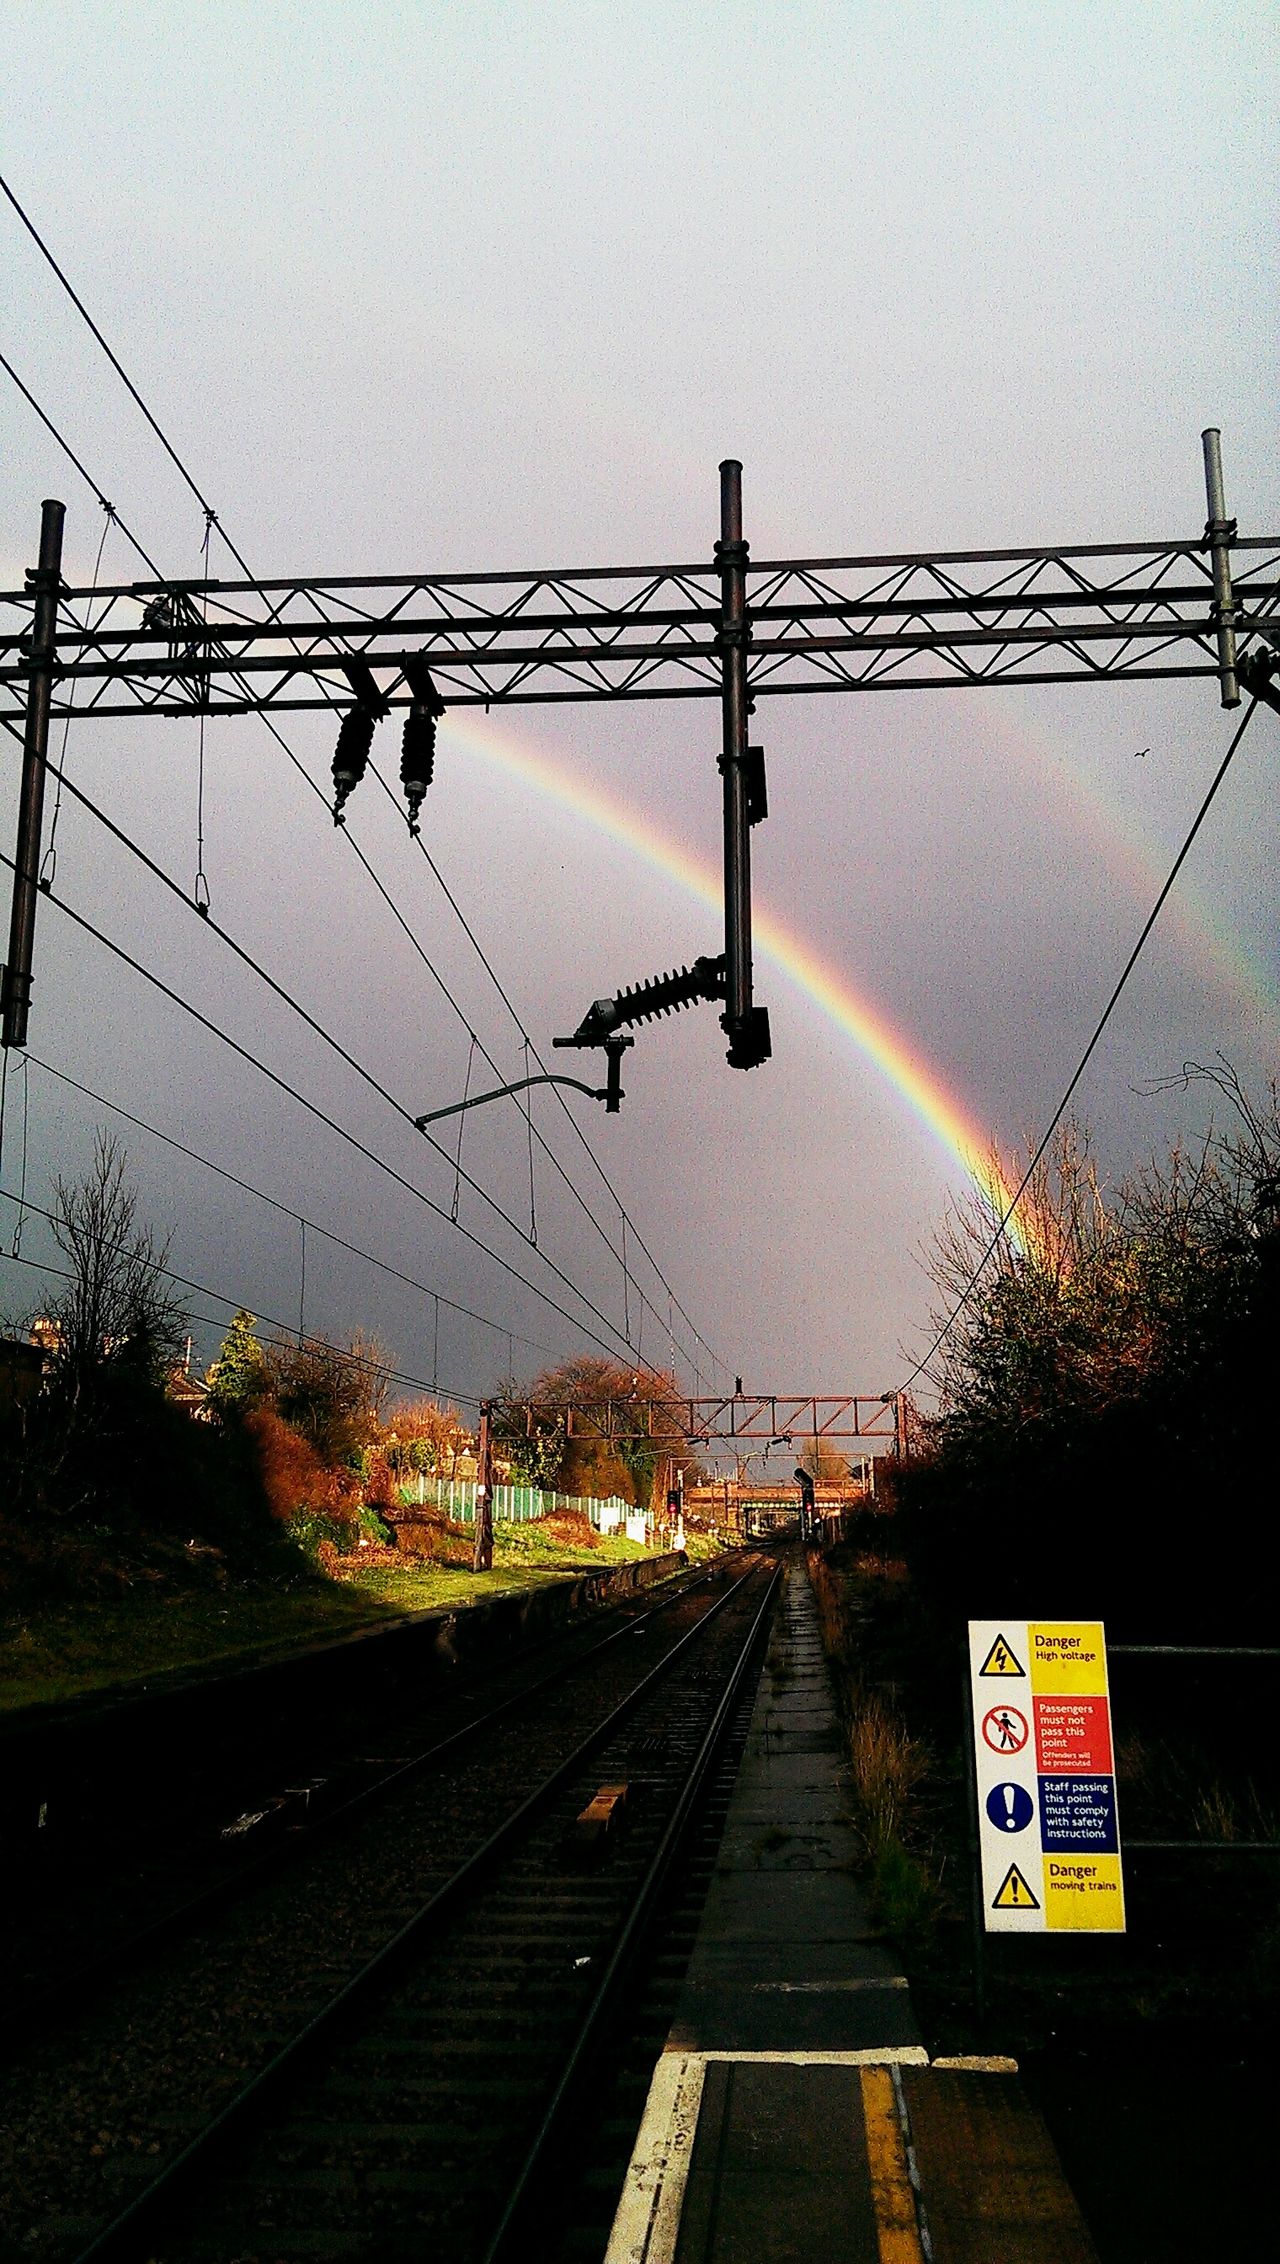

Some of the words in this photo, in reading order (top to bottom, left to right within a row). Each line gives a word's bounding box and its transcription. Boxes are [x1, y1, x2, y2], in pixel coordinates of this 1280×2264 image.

[1035, 1635, 1081, 1649] Danger
[1036, 1651, 1057, 1661] High
[1061, 1652, 1096, 1662] voltage
[1039, 1704, 1093, 1715] Passengers
[1040, 1716, 1064, 1724] must
[1068, 1716, 1085, 1724] not
[1041, 1728, 1063, 1737] pass
[1066, 1727, 1085, 1736] this
[1041, 1739, 1068, 1749] point
[1053, 1760, 1091, 1768] prosecuted
[1044, 1782, 1069, 1791] Staff
[1072, 1782, 1108, 1793] passing
[1045, 1794, 1064, 1803] this
[1067, 1795, 1092, 1804] point
[1046, 1806, 1071, 1814] must
[1074, 1806, 1108, 1816] comply
[1047, 1818, 1069, 1826] with
[1072, 1818, 1103, 1828] safety
[1047, 1829, 1106, 1838] instructions
[1050, 1864, 1097, 1879] Danger
[1051, 1882, 1085, 1892] moving
[1088, 1882, 1116, 1890] trains
